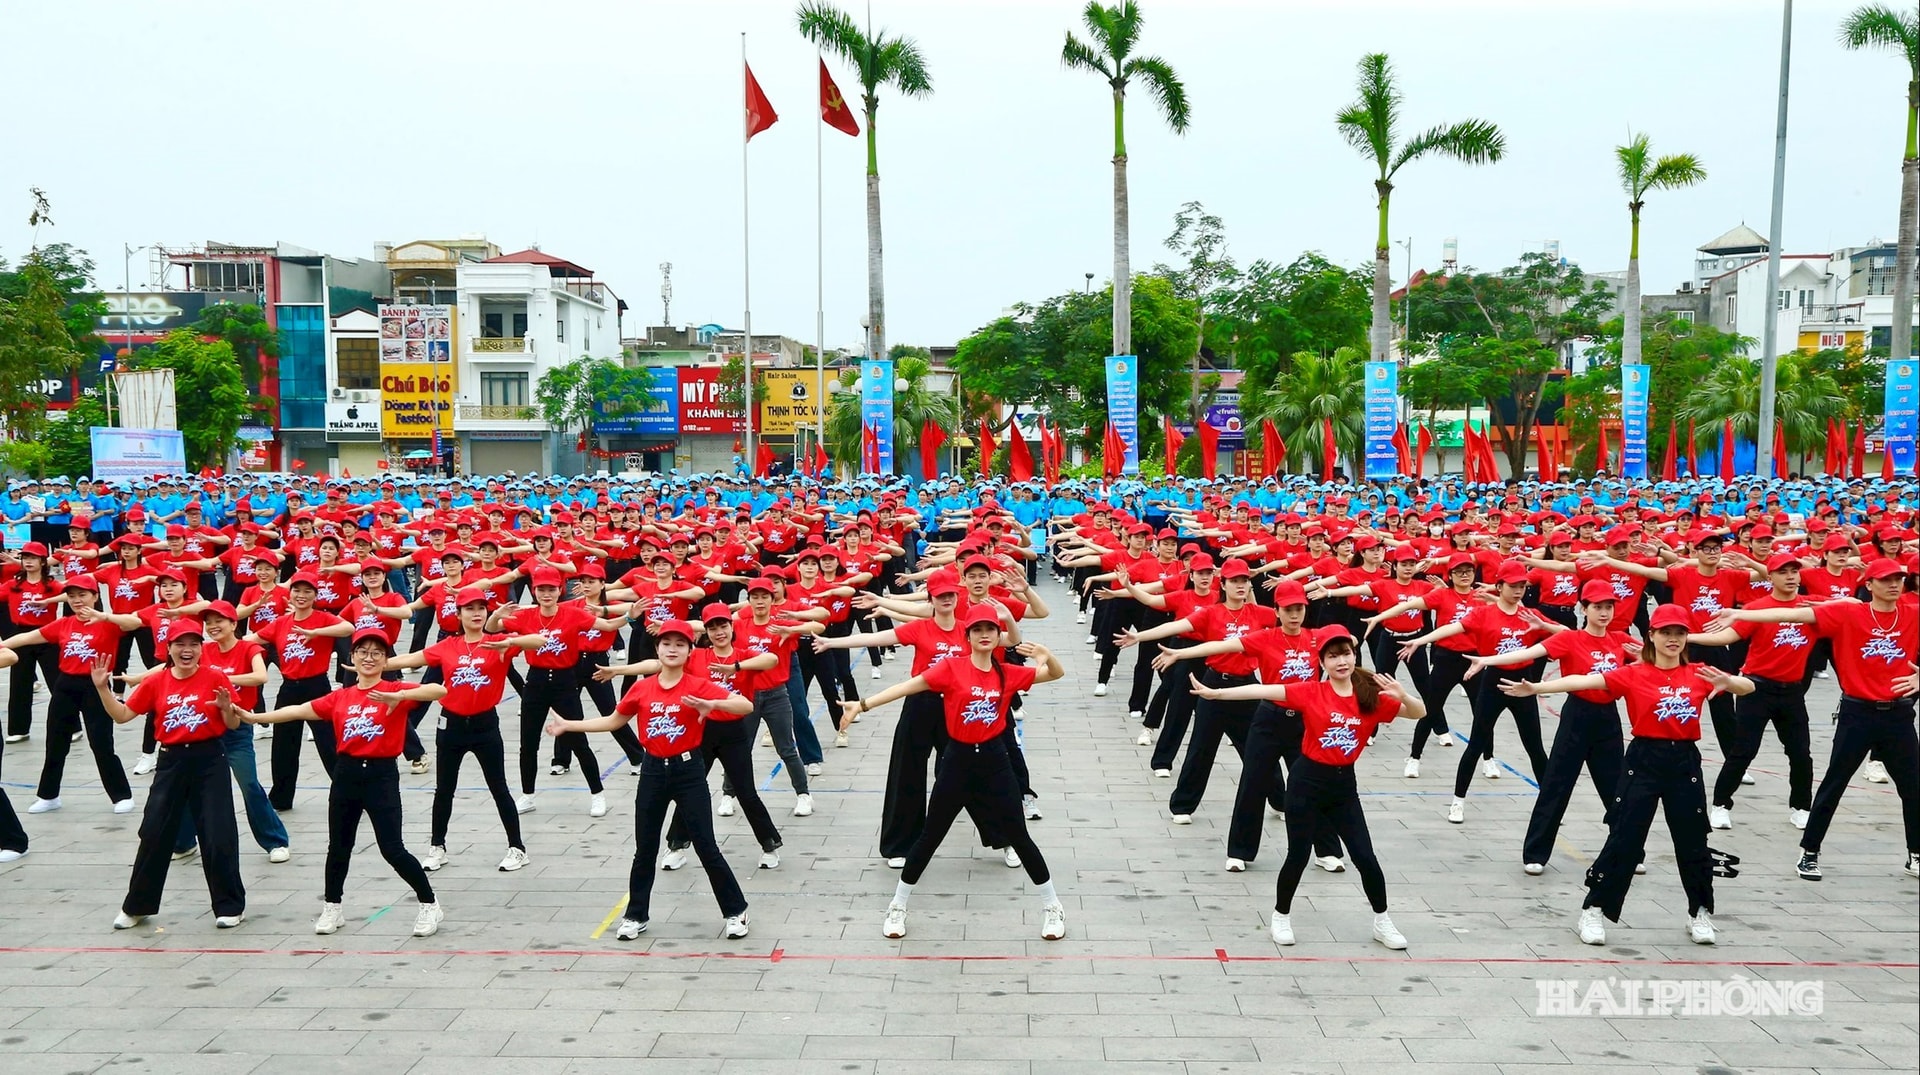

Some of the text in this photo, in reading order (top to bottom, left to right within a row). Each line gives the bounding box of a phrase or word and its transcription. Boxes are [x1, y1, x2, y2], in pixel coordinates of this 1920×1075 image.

[382, 308, 406, 317] BÁNH
[382, 374, 415, 393] Chú
[682, 378, 706, 403] MỸ
[384, 400, 416, 411] Döner
[687, 406, 725, 418] KHÁNH
[767, 405, 790, 418] THỊNH
[793, 403, 808, 416] TÓC
[395, 413, 441, 424] Fastfo
[650, 702, 681, 716] Tôi yêu
[647, 715, 677, 728] Hải
[645, 724, 687, 744] Phòng
